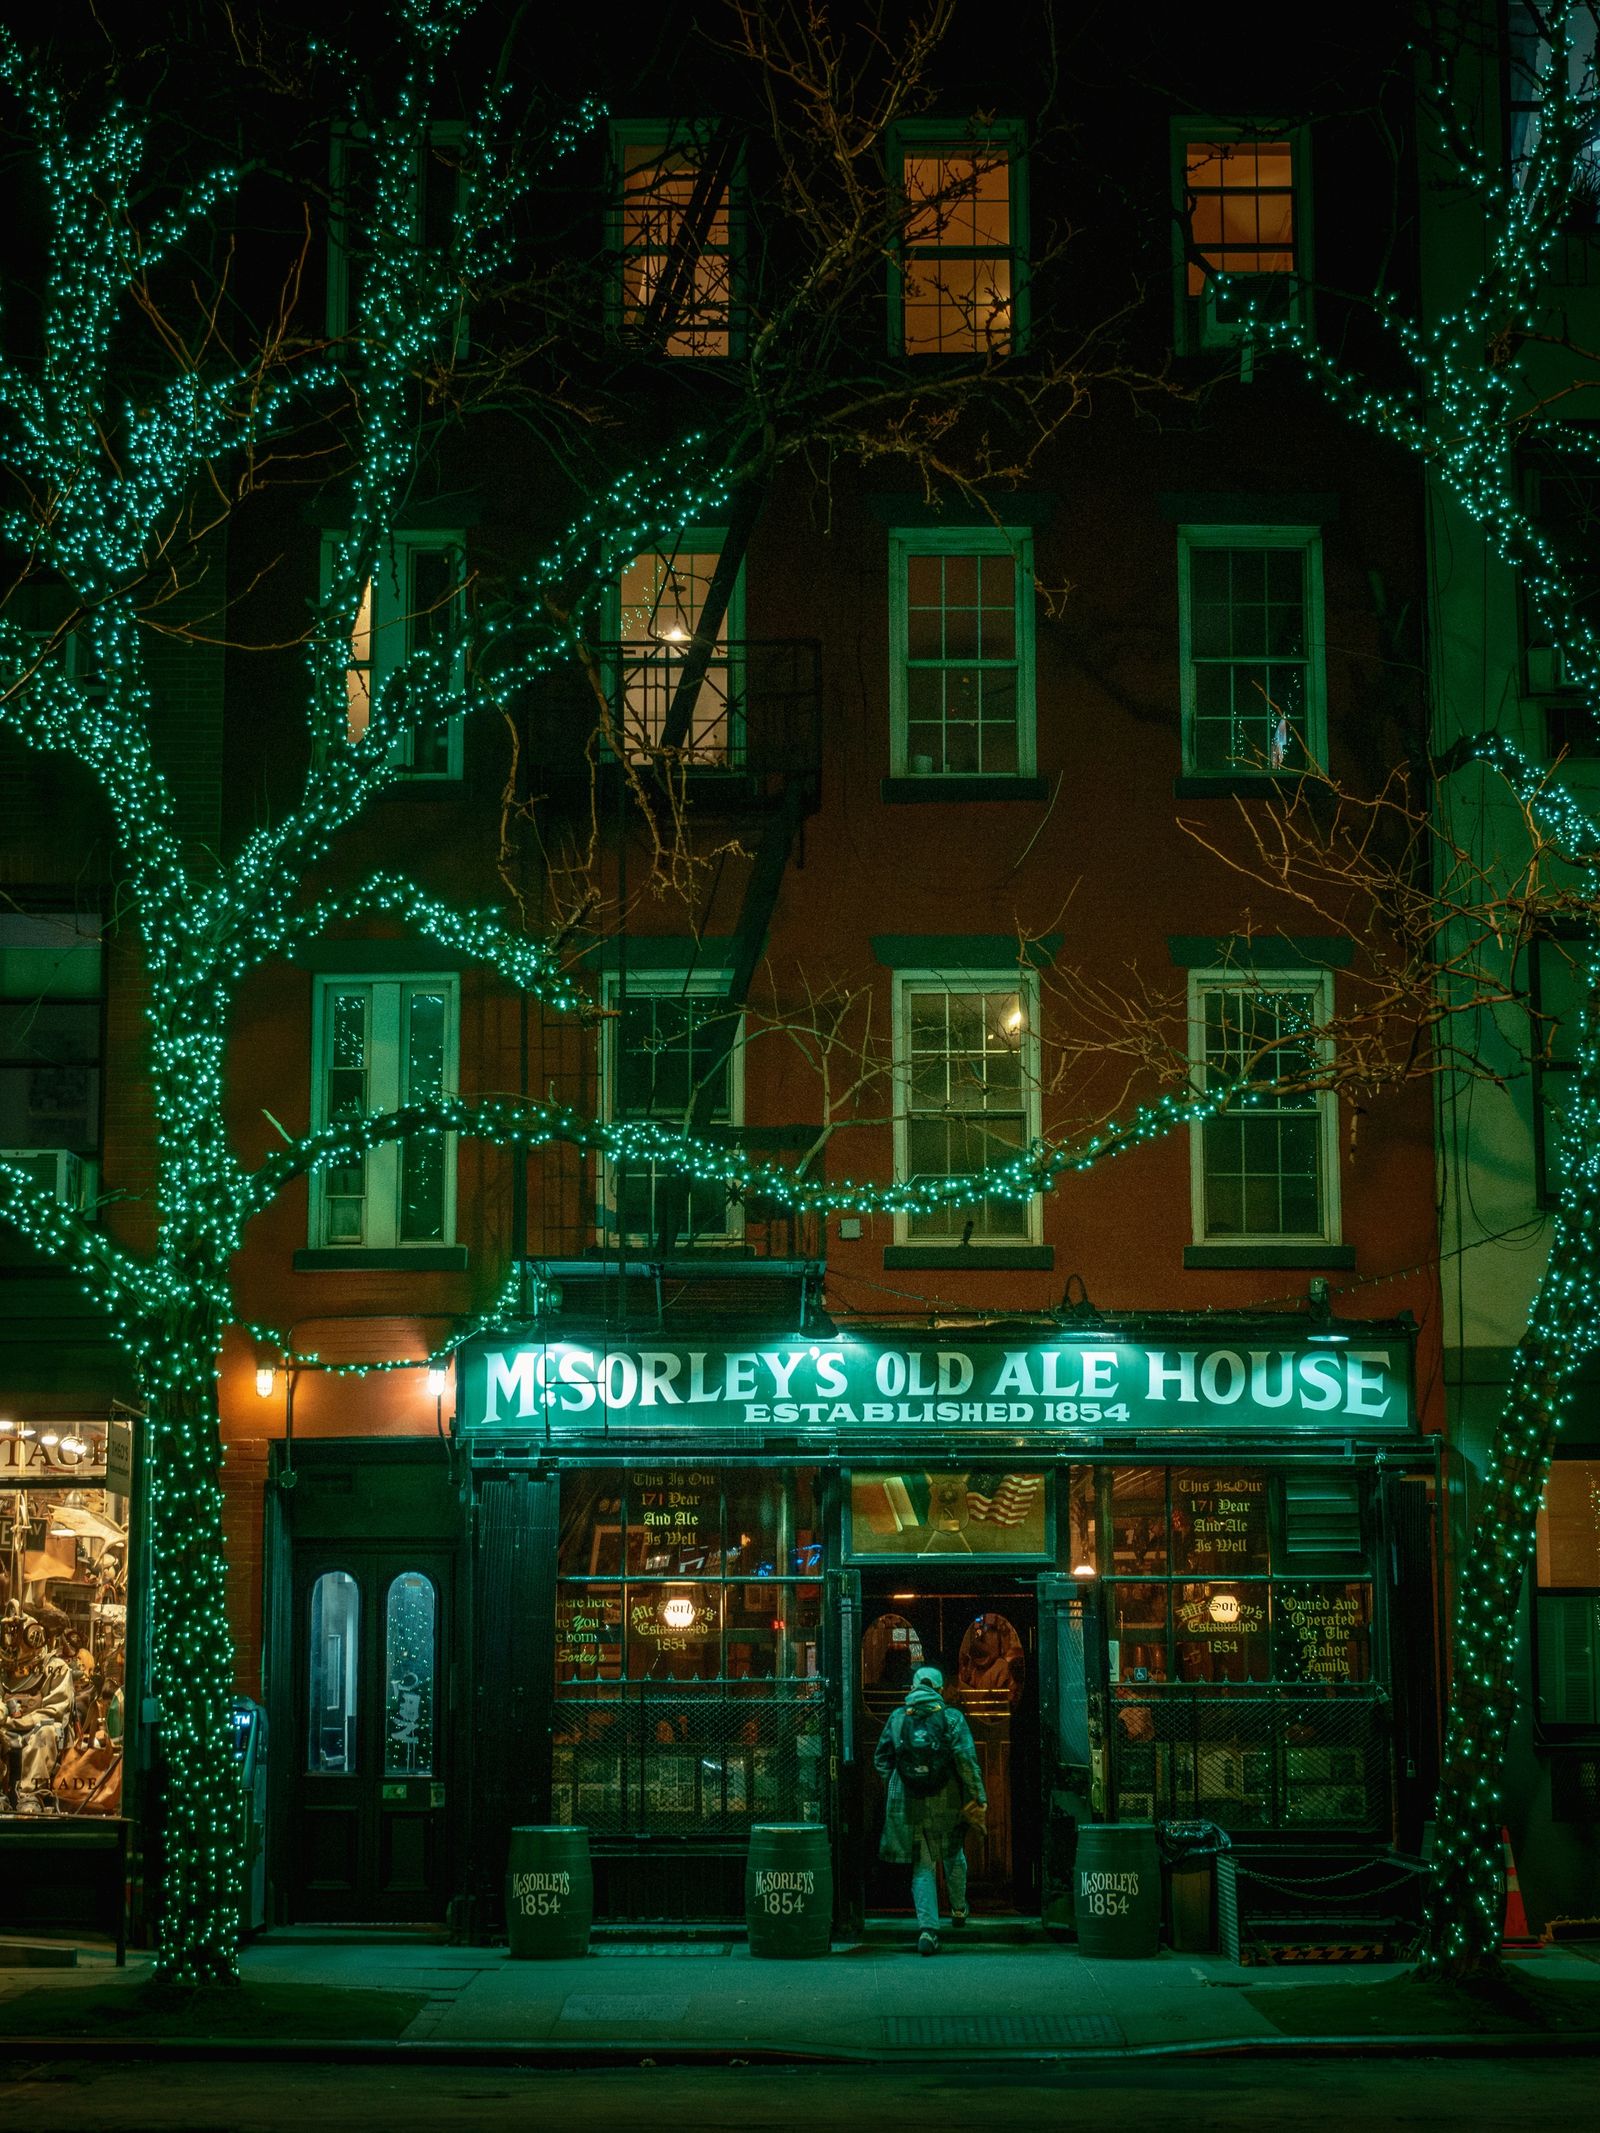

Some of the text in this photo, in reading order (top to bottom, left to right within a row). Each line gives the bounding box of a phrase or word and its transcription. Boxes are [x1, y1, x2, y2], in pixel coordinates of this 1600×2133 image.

[876, 1351, 974, 1397] OLD
[990, 1352, 1119, 1398] ALE
[1145, 1350, 1391, 1418] HOUSE
[744, 1402, 1130, 1424] ESTABLISHED 1854
[1179, 1480, 1210, 1494] This
[1234, 1480, 1262, 1493] Our
[668, 1491, 700, 1508] Year
[1218, 1499, 1250, 1515] Year
[643, 1511, 699, 1526] And Ale
[1194, 1518, 1248, 1532] And Ale
[643, 1531, 698, 1546] Is Well
[1215, 1539, 1247, 1552] Well
[1283, 1595, 1359, 1611] Owned And
[572, 1614, 599, 1632] You
[1291, 1611, 1355, 1629] Operated
[1299, 1626, 1350, 1644] By The
[655, 1638, 687, 1651] 1854
[1208, 1640, 1239, 1653] 1854
[1301, 1642, 1348, 1659] Maher
[1302, 1658, 1350, 1676] Family
[233, 1714, 250, 1725] TM
[31, 1777, 98, 1791] TRADE
[520, 1893, 561, 1916] 1854
[763, 1892, 805, 1915] 1854
[1088, 1893, 1130, 1916] 1854
